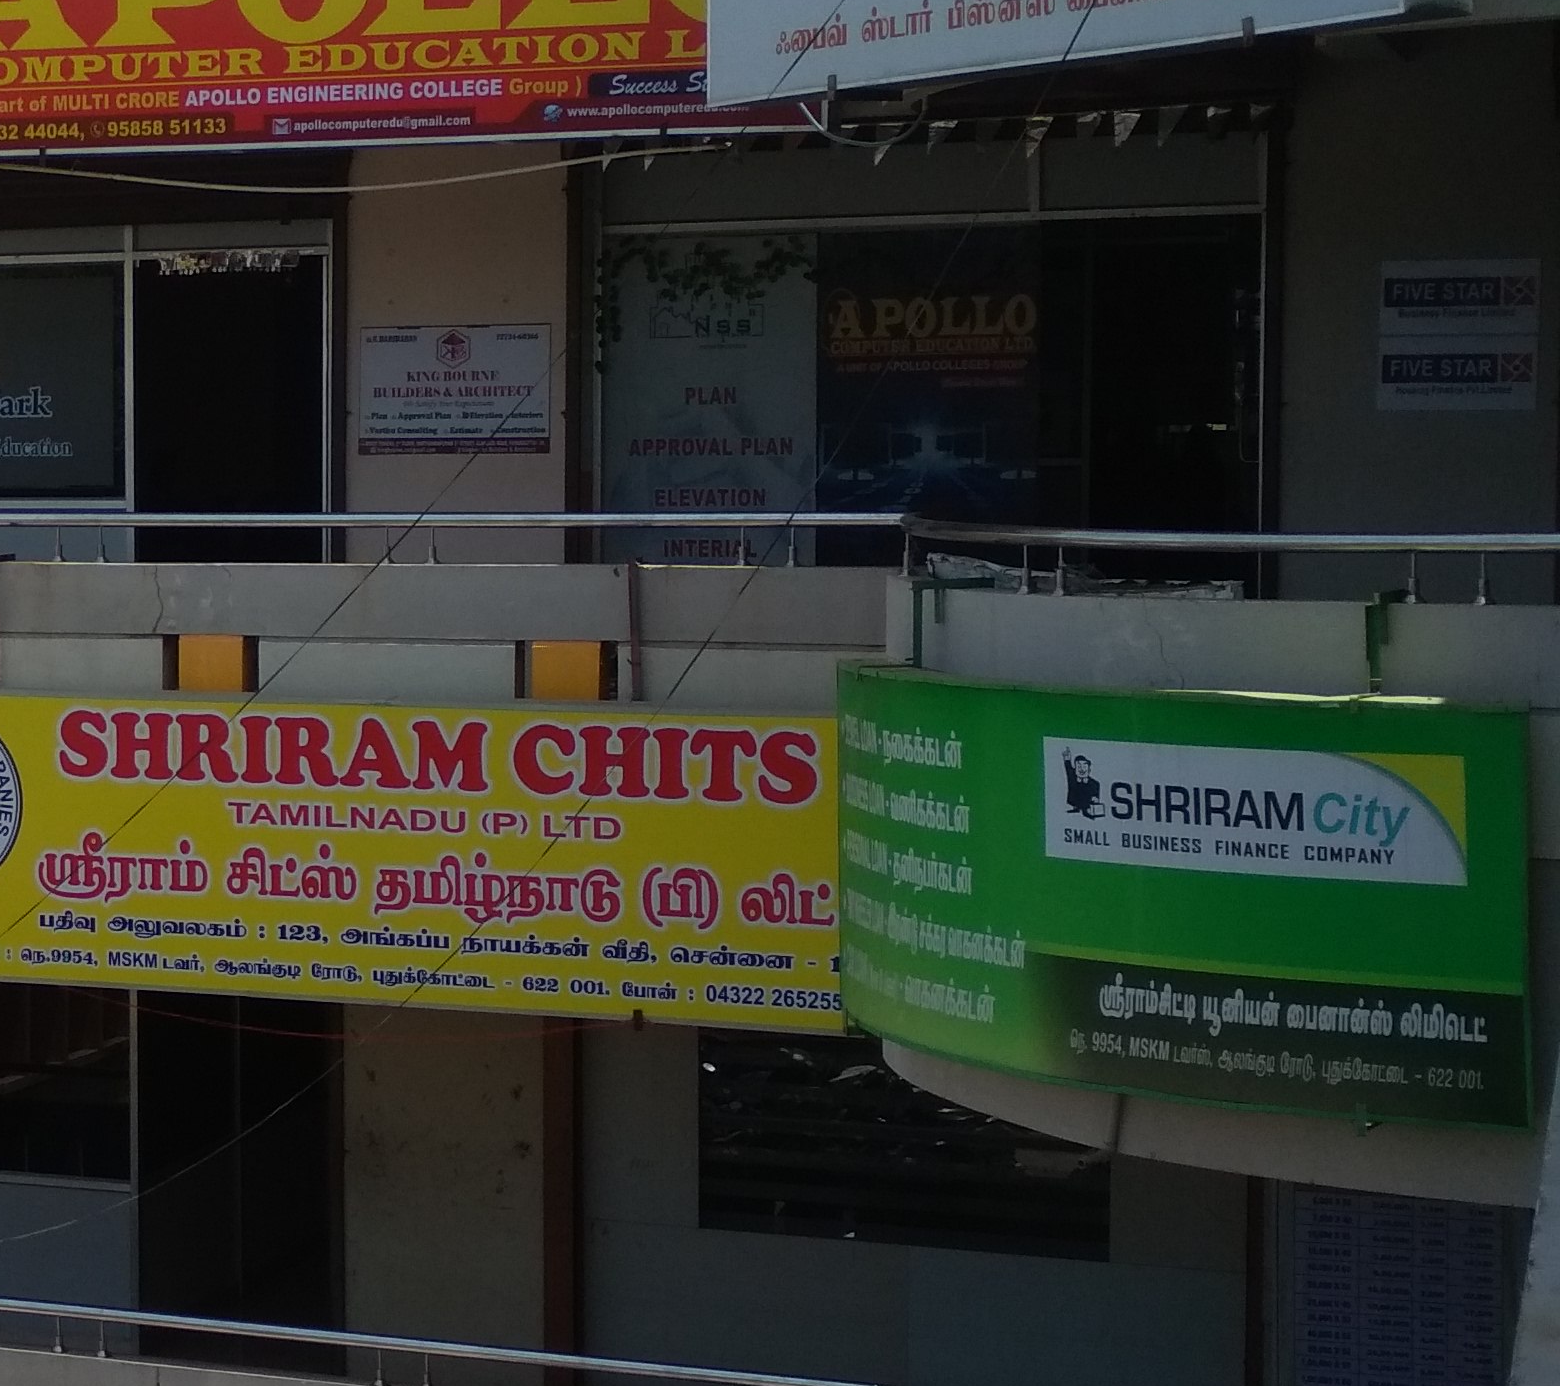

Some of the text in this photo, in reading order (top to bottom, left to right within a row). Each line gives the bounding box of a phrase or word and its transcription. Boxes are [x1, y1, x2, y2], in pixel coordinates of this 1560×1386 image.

[282, 31, 646, 75] EDUCATION
[29, 93, 47, 112] of
[53, 94, 109, 111] MULTI
[116, 92, 179, 109] CRORE
[185, 88, 261, 107] APOLLO
[268, 83, 403, 104] ENGINEERING
[410, 79, 502, 98] COLLEGE
[509, 77, 568, 95] Group
[609, 75, 678, 95] Success
[24, 123, 84, 140] 44044,
[107, 118, 226, 137] 95858 51133
[1393, 283, 1495, 300] FIVE STAR
[831, 294, 1037, 339] APOLLO
[407, 370, 499, 382] KING BOURNE
[1390, 359, 1492, 376] FIVE STAR
[373, 386, 534, 397] BUILDERS ARCHITECT
[686, 387, 737, 405] PLAN
[629, 437, 793, 456] APPROVAL PLAN
[655, 489, 766, 507] ELEVATION
[58, 709, 489, 793] SHRIRAM
[513, 724, 819, 805] CHITS
[227, 801, 622, 841] TAMILNADU (P) LTD
[1110, 781, 1411, 847] SHRIRAM City
[1063, 828, 1395, 866] SMALL BUSINESS FINANCE COMPANY
[375, 852, 622, 925] தமிழ்நாடு
[108, 953, 158, 970] MSKM
[706, 985, 764, 1005] 04322
[1129, 1039, 1453, 1087] MSKM 622
